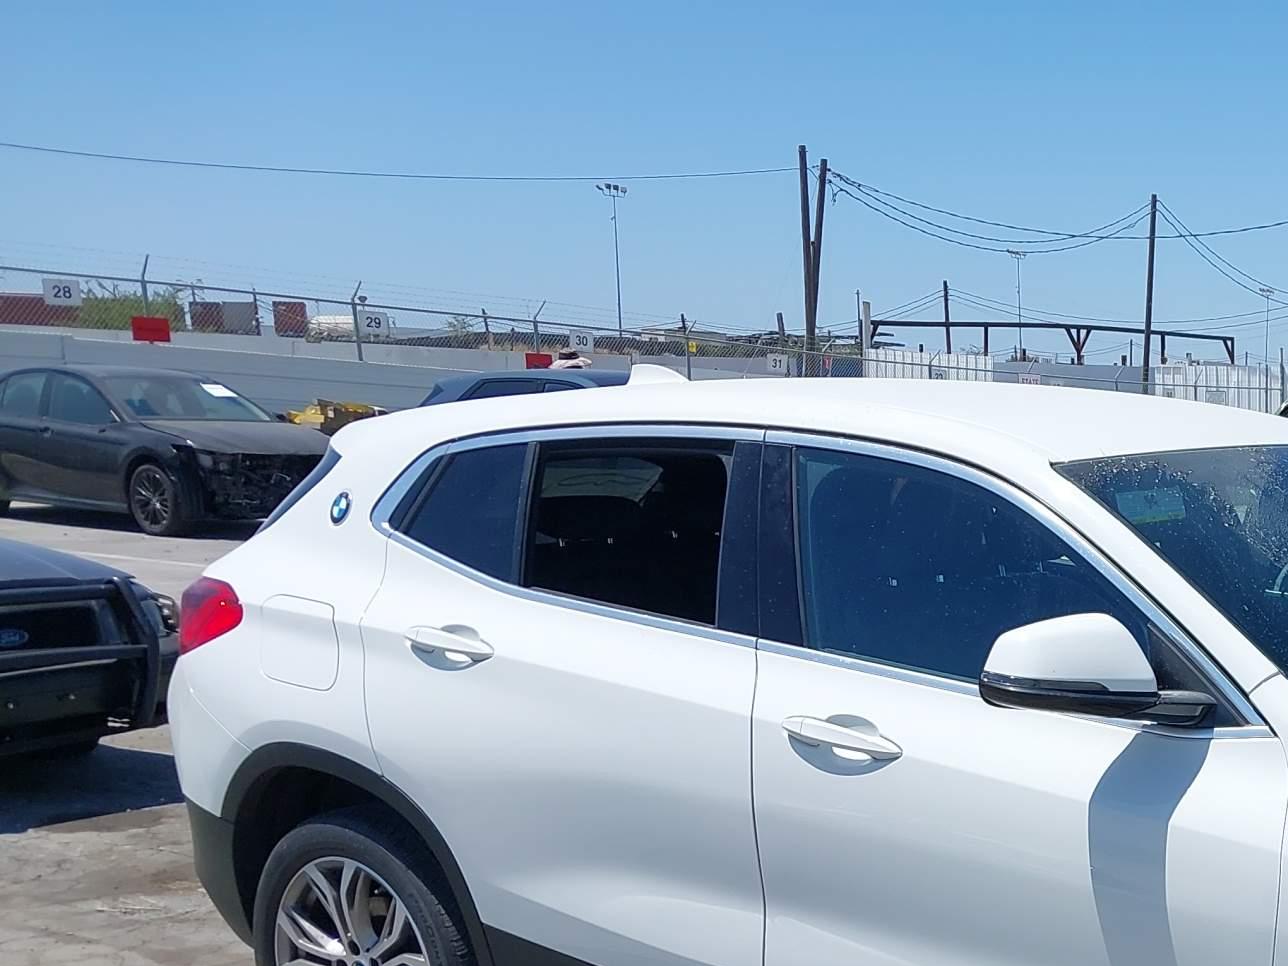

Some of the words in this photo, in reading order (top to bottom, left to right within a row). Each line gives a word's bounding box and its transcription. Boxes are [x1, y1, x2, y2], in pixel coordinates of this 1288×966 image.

[52, 284, 72, 299] 28
[366, 316, 381, 329] 29
[575, 334, 588, 347] 30
[771, 358, 783, 369] 31
